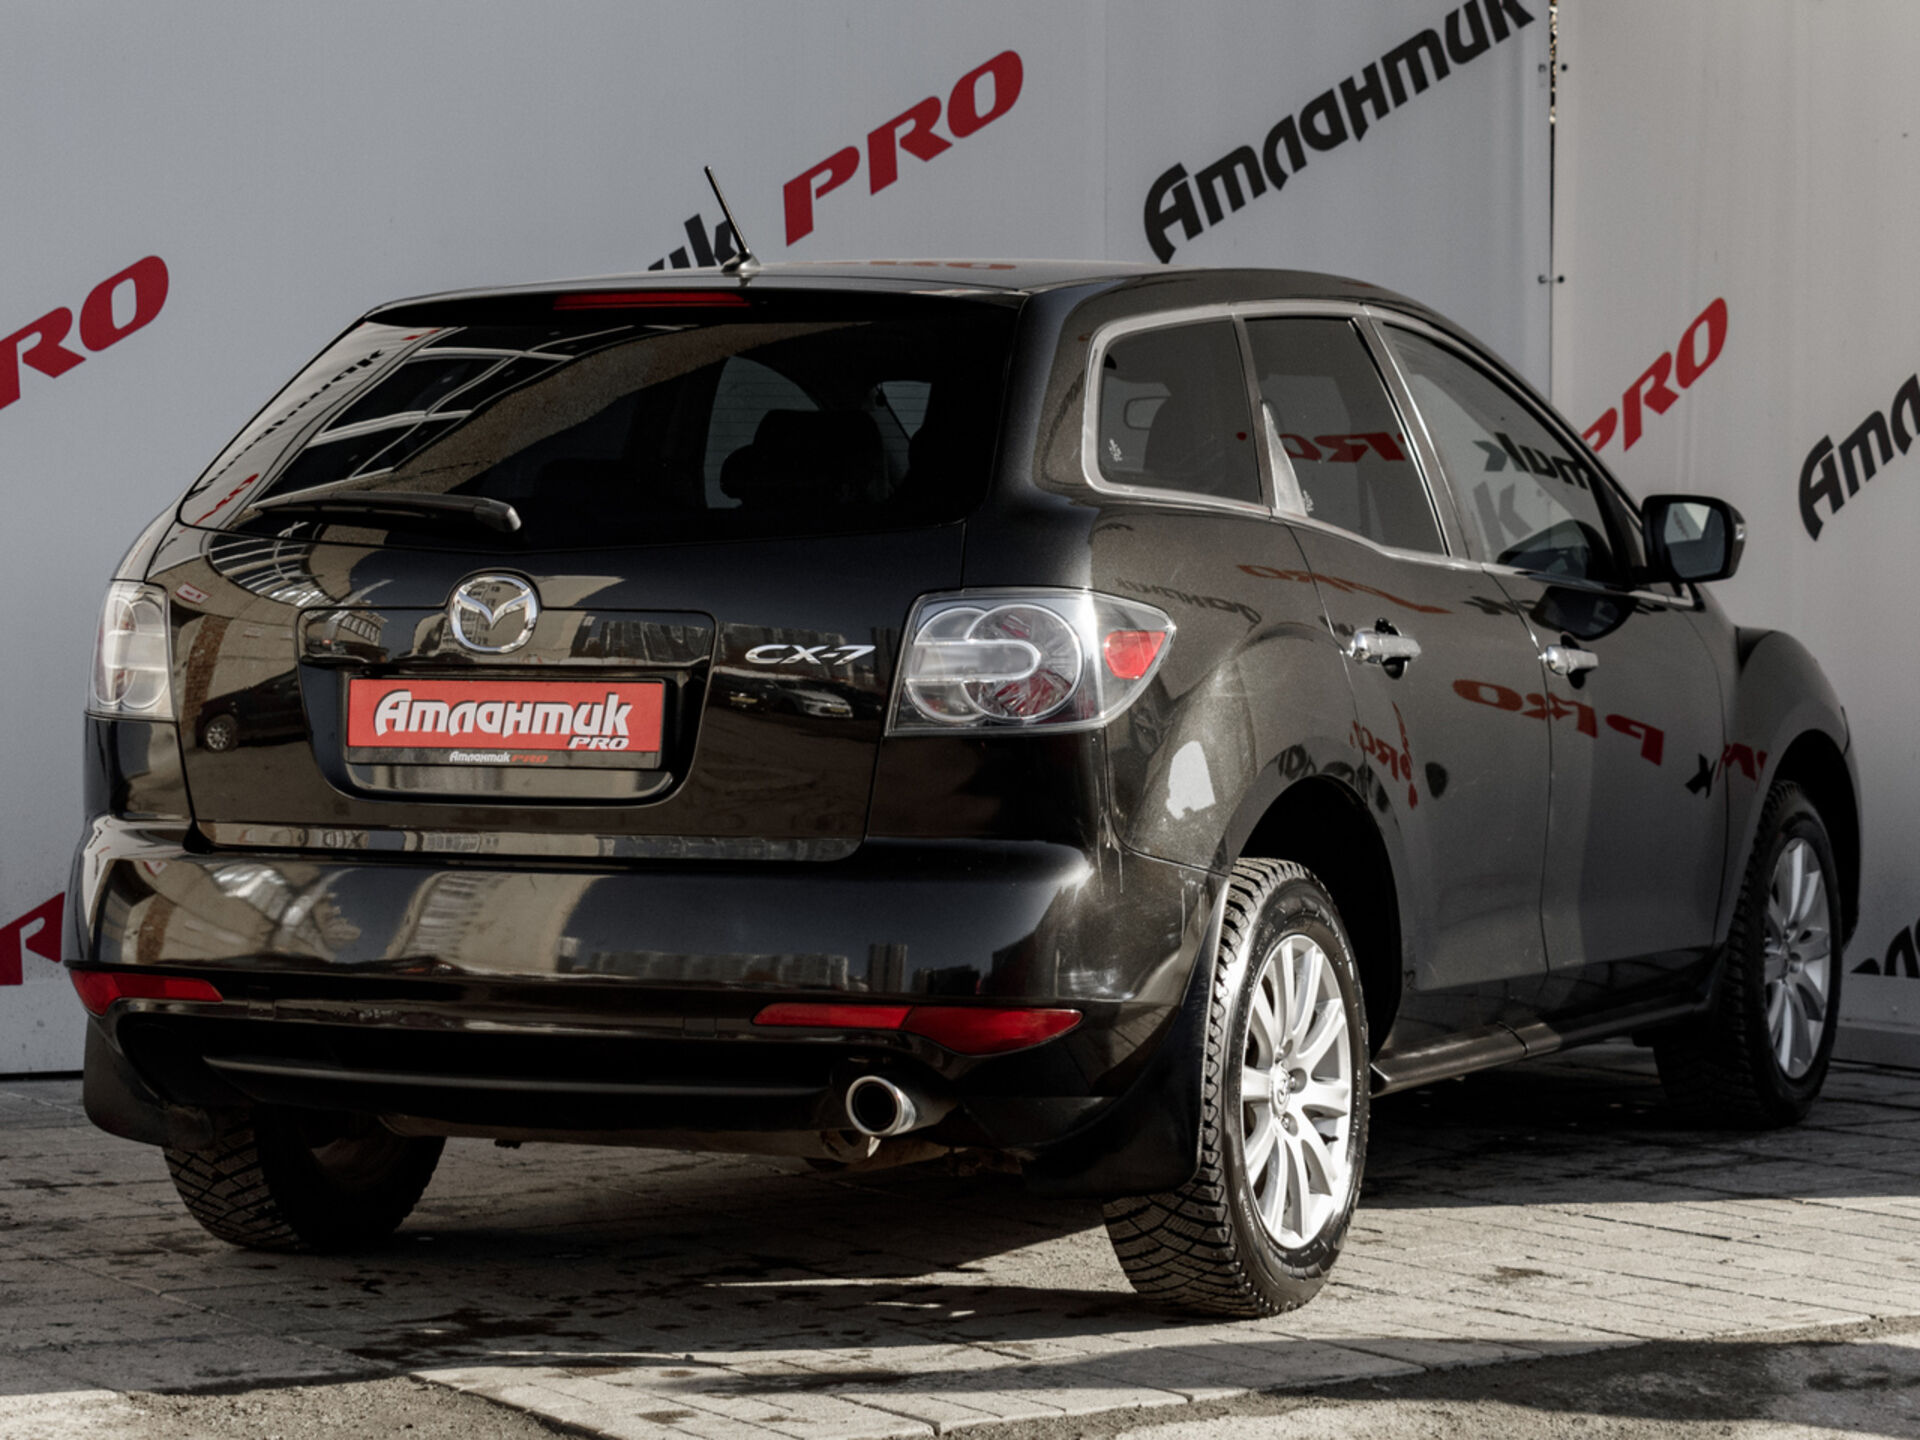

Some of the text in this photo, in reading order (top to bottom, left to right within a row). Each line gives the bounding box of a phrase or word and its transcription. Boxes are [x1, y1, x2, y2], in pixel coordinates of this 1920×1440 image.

[783, 50, 1024, 247] PRO
[744, 644, 876, 665] CX-7
[375, 690, 633, 738] Атлантик
[567, 736, 630, 750] PRO
[511, 753, 549, 764] PRO
